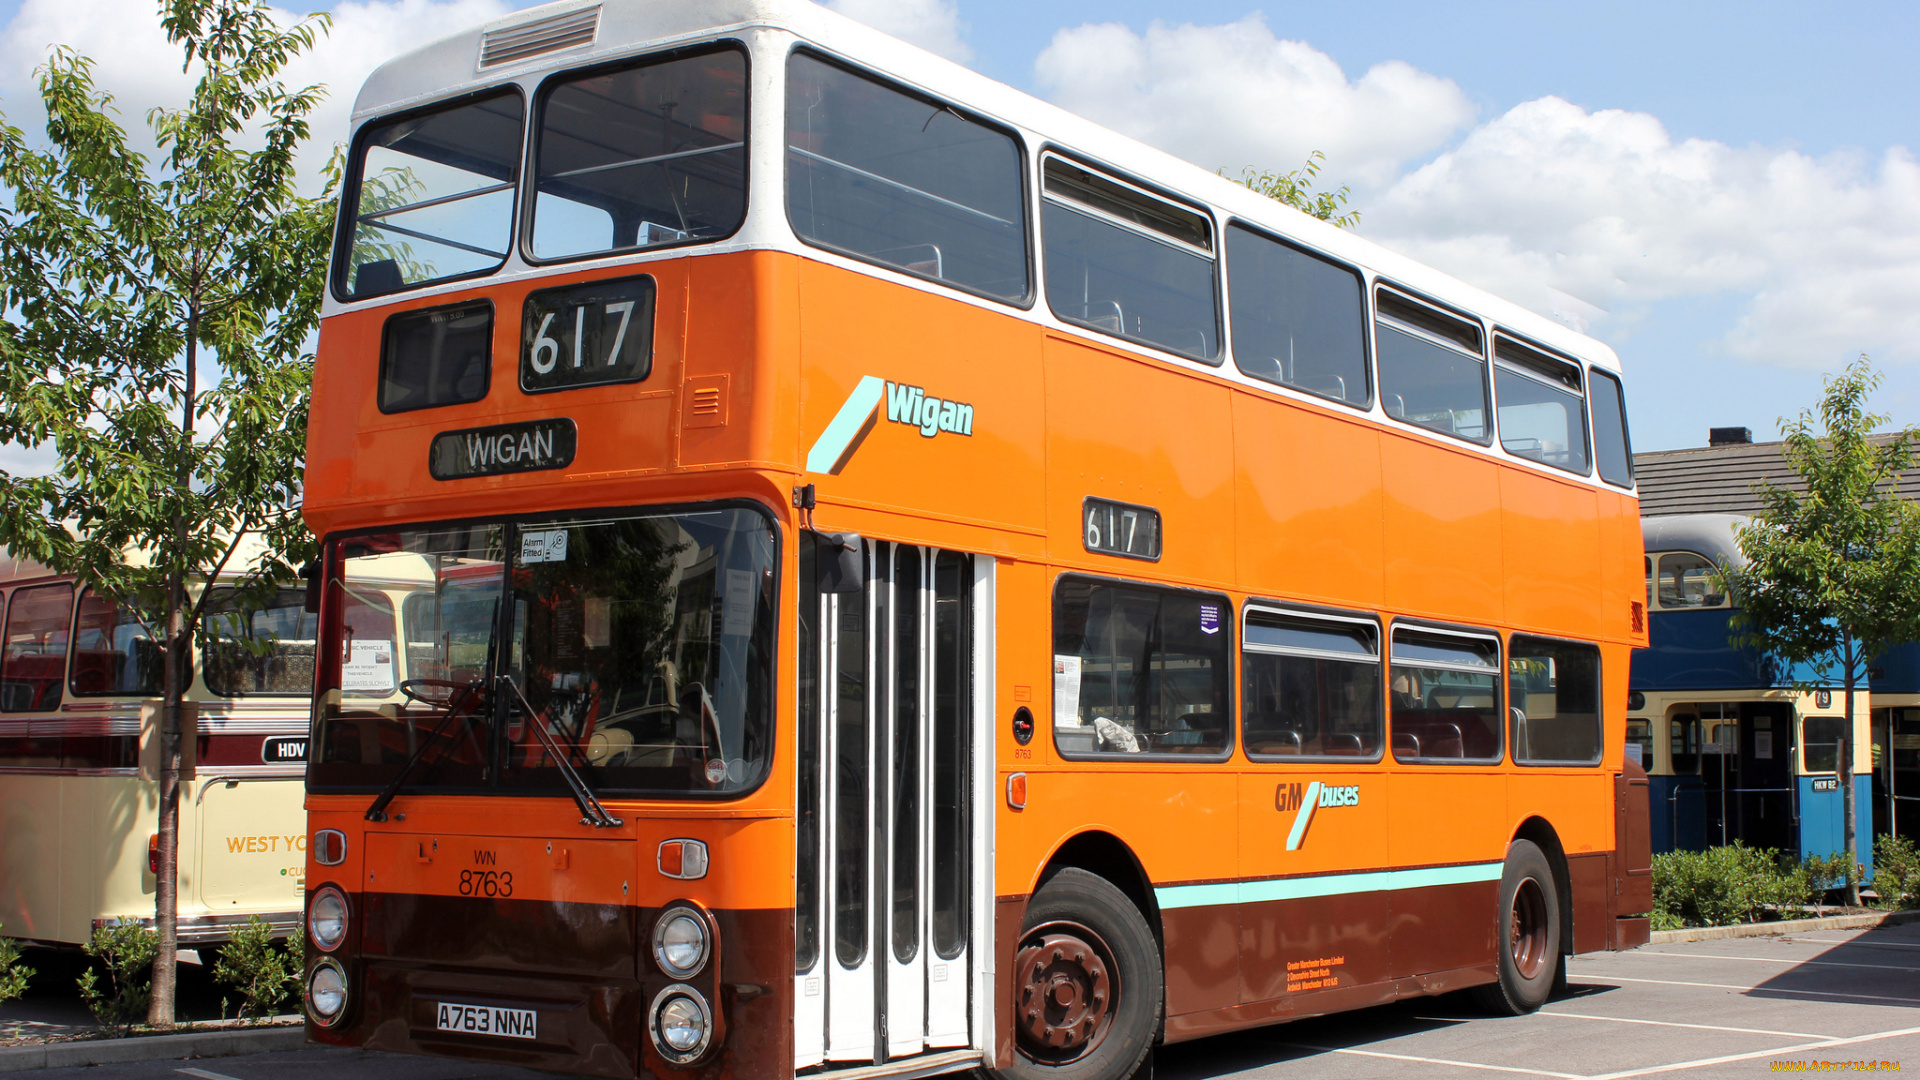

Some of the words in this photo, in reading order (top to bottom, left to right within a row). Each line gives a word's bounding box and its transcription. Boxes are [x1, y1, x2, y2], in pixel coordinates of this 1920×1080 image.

[531, 301, 635, 374] 617
[885, 380, 974, 438] Wigan
[466, 429, 553, 467] WIGAN
[1087, 505, 1138, 553] 617
[523, 538, 544, 547] Alarm
[522, 549, 542, 557] Fitted
[1816, 690, 1829, 704] 79
[277, 742, 306, 758] HDV
[1015, 748, 1032, 759] 8763
[1814, 780, 1828, 790] HKW
[1275, 782, 1303, 812] GM
[1318, 782, 1360, 808] buses
[226, 835, 280, 854] WEST
[473, 849, 497, 866] WN
[458, 869, 514, 898] 8763
[438, 1004, 490, 1033] A763
[495, 1009, 535, 1037] NNA
